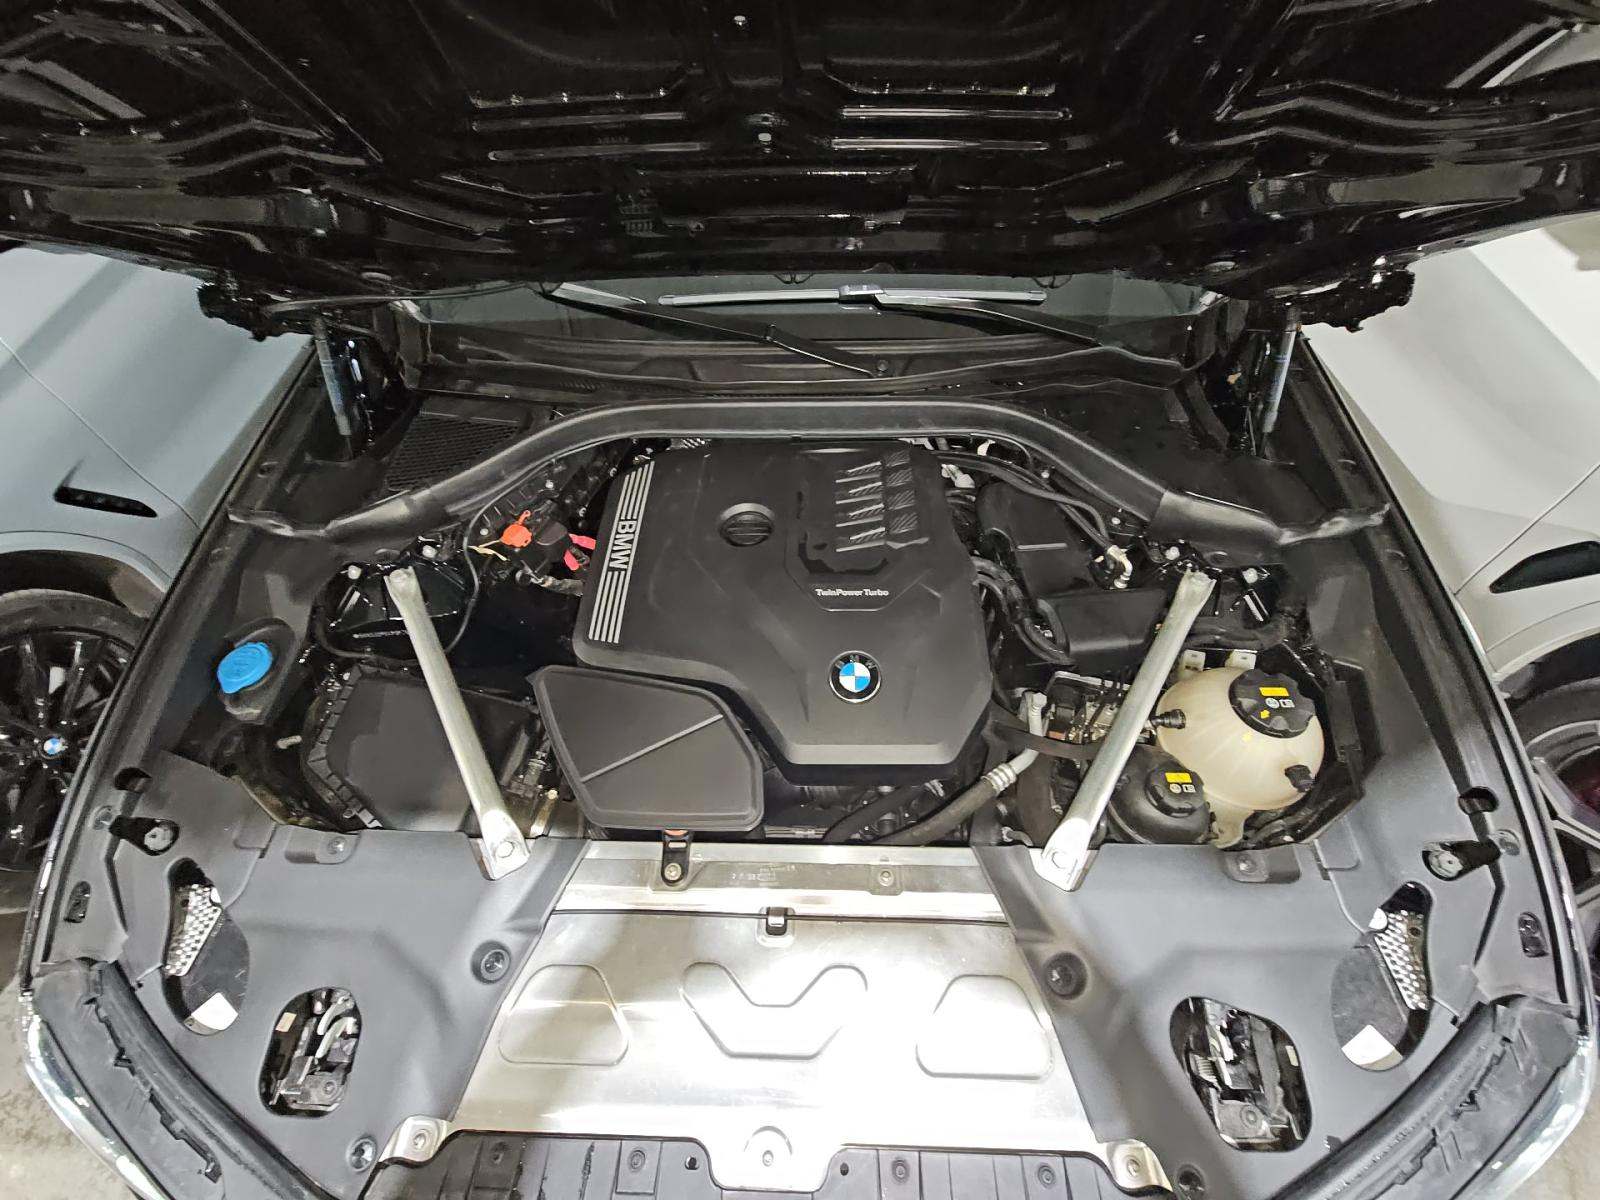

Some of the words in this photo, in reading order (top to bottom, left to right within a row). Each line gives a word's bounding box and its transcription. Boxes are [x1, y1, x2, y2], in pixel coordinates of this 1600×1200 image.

[609, 520, 637, 569] BMW
[863, 588, 890, 597] Turbo
[834, 654, 878, 670] BMW
